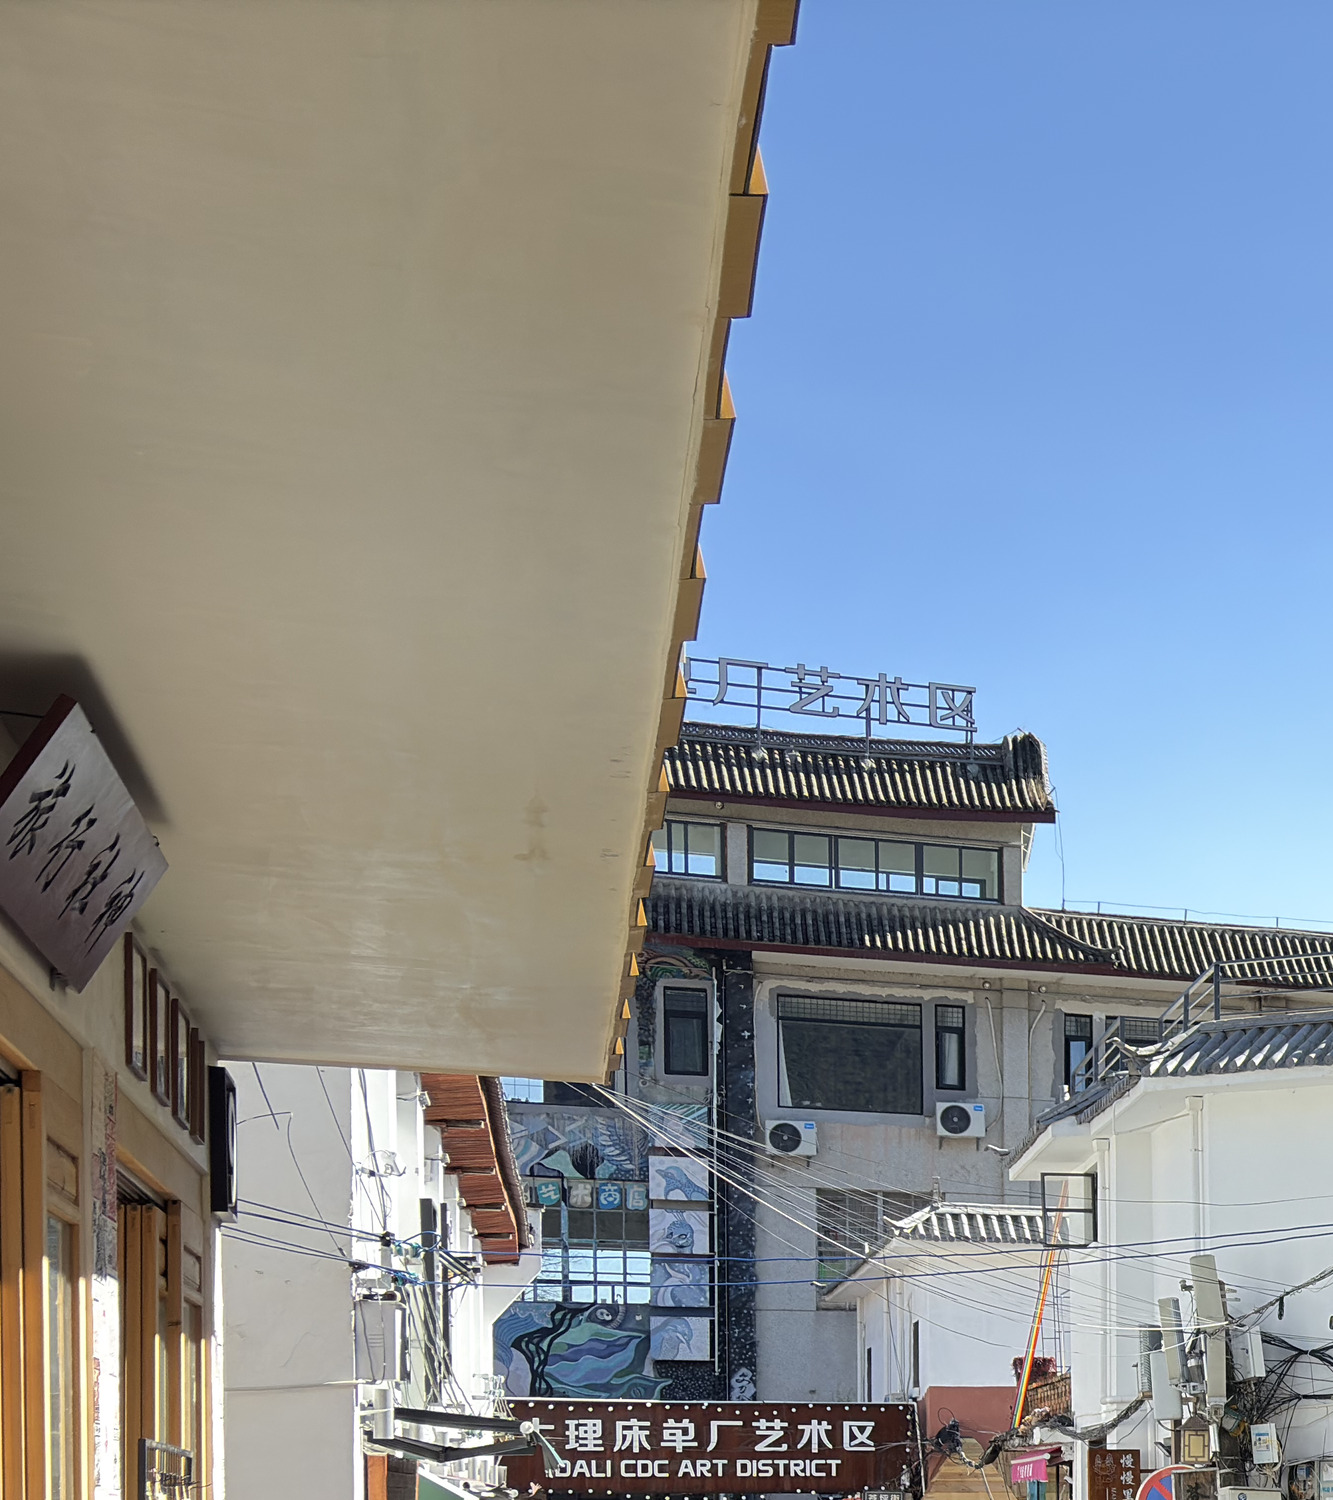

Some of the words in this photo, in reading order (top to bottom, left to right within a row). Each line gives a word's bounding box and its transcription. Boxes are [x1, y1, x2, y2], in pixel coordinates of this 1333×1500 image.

[684, 656, 978, 733] 厂艺术区
[555, 1459, 612, 1478] DALI
[620, 1459, 670, 1478] CDC
[678, 1459, 728, 1478] ART
[736, 1459, 842, 1478] DISTRICT
